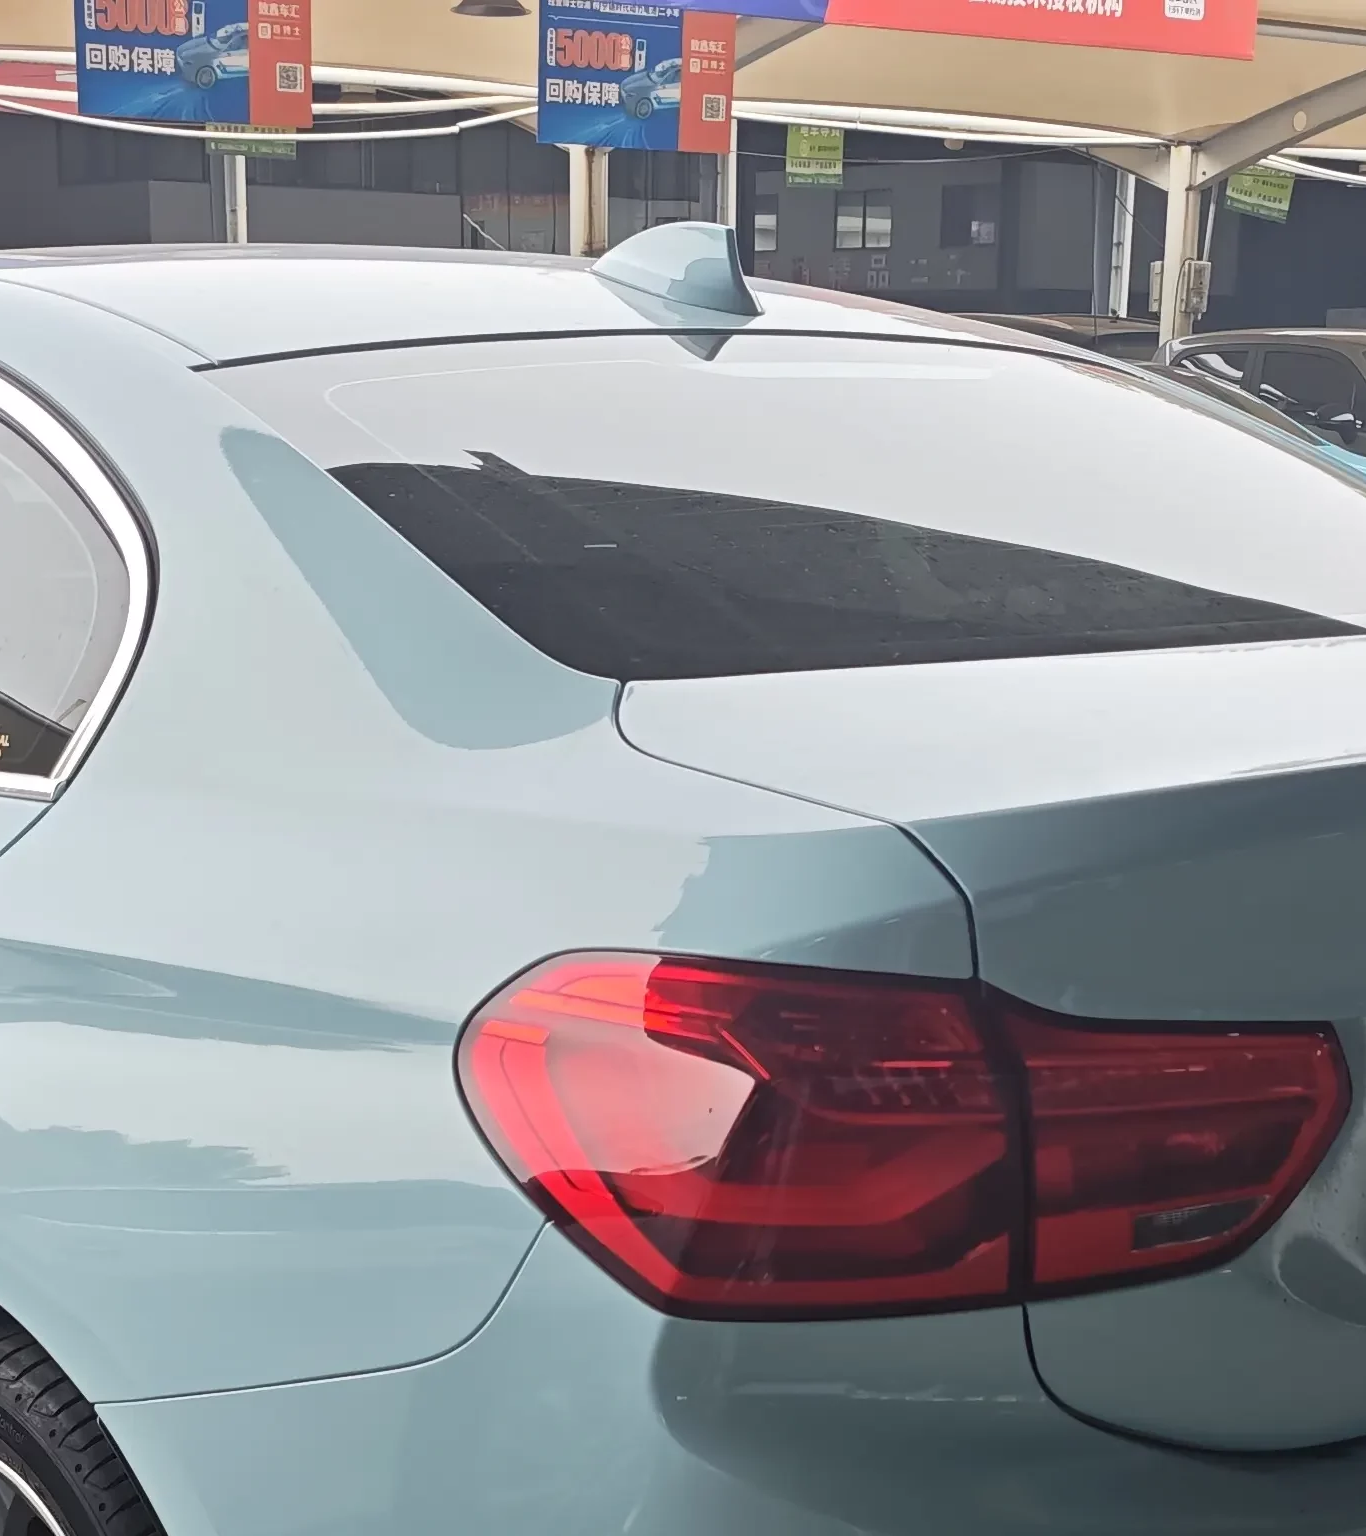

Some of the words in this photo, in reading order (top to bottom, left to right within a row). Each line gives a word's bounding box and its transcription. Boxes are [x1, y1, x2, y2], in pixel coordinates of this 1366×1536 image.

[85, 43, 176, 75] 回购保障
[556, 28, 621, 71] 5000
[546, 78, 620, 107] 回购保障
